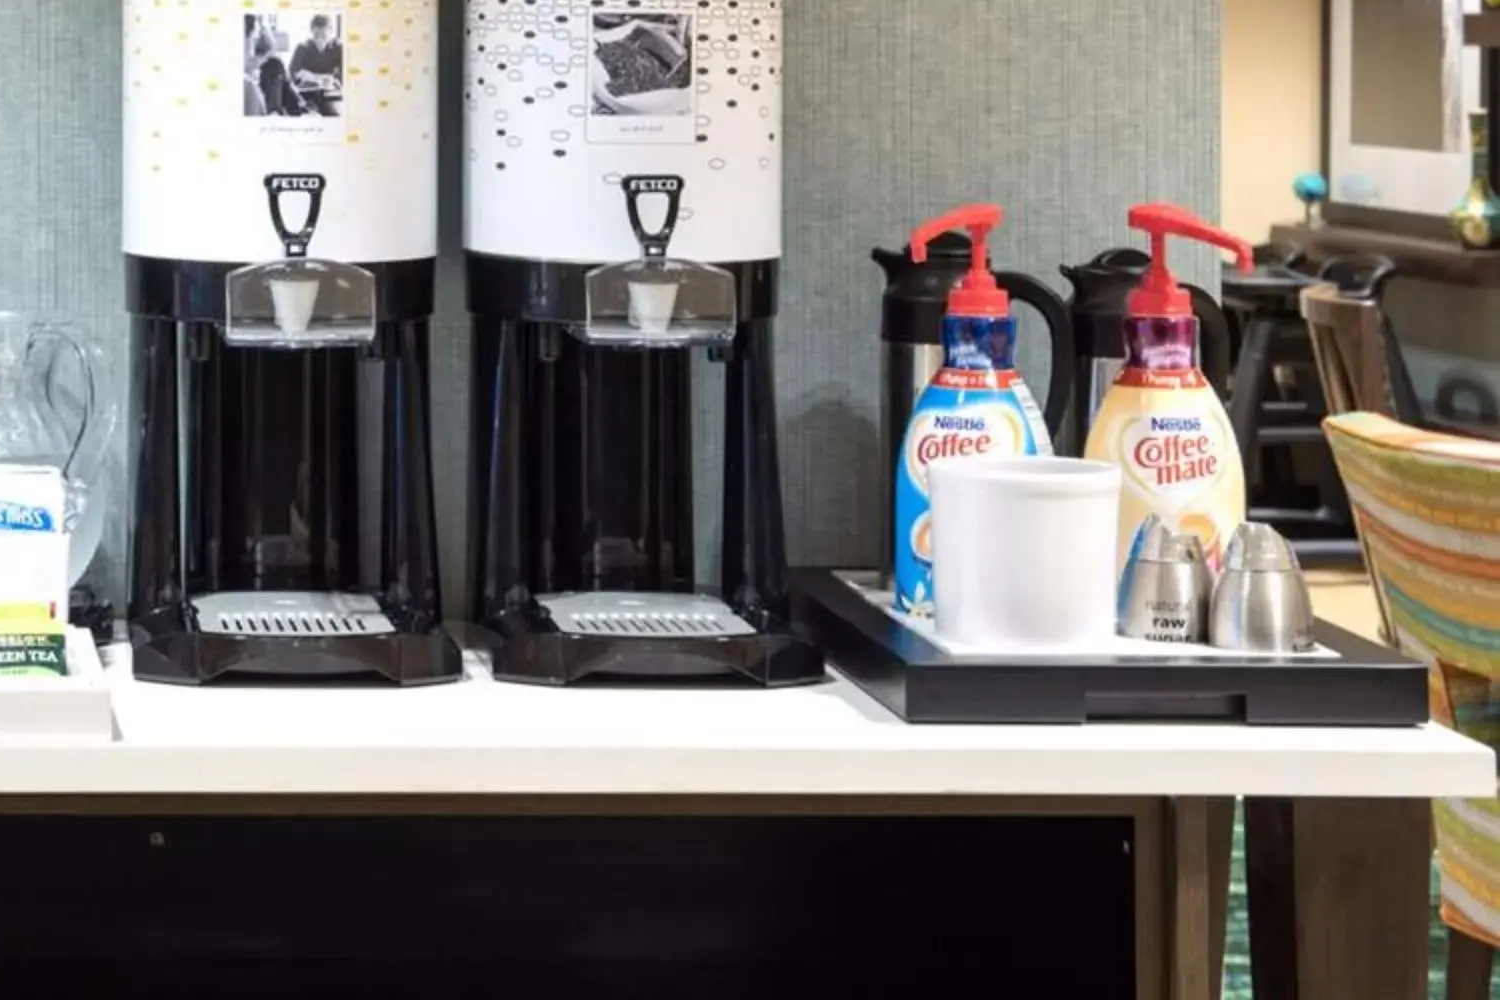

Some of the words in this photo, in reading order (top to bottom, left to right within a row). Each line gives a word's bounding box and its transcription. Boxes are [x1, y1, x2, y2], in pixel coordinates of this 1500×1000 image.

[272, 177, 320, 189] FETCO
[630, 179, 678, 191] FETCO
[917, 433, 992, 465] Coffee
[1133, 435, 1210, 468] Coffee
[1156, 455, 1217, 485] mate
[1153, 617, 1186, 629] raw
[28, 650, 58, 663] TEA
